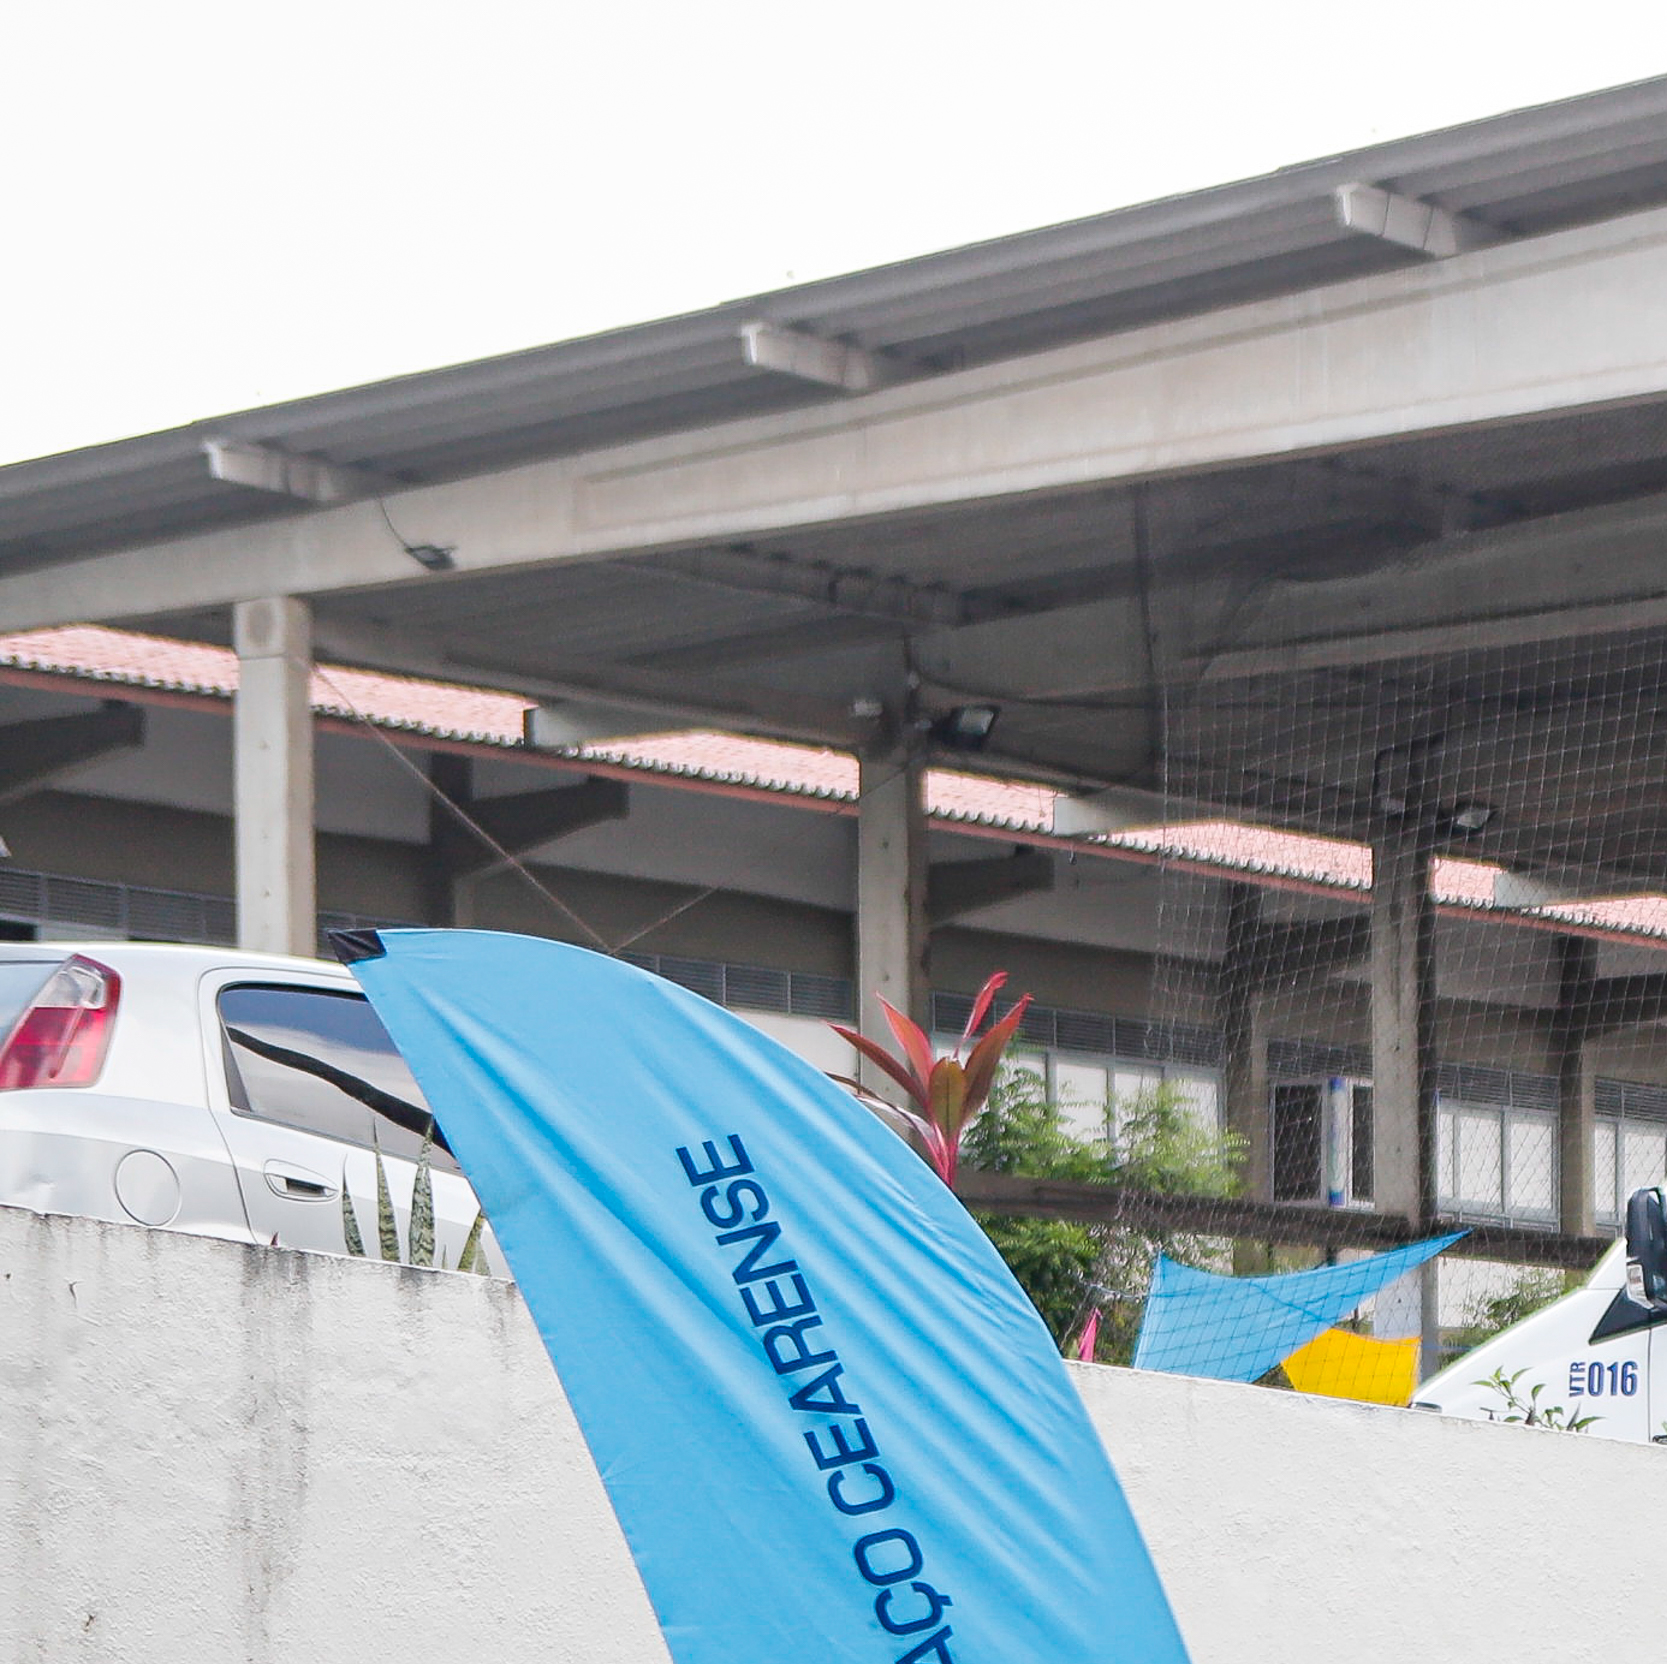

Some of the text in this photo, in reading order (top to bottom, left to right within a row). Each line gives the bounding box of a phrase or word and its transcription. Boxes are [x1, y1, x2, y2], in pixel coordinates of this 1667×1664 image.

[676, 1133, 895, 1516] CEARENSE
[1569, 1362, 1586, 1397] VTR
[1588, 1360, 1638, 1397] 016
